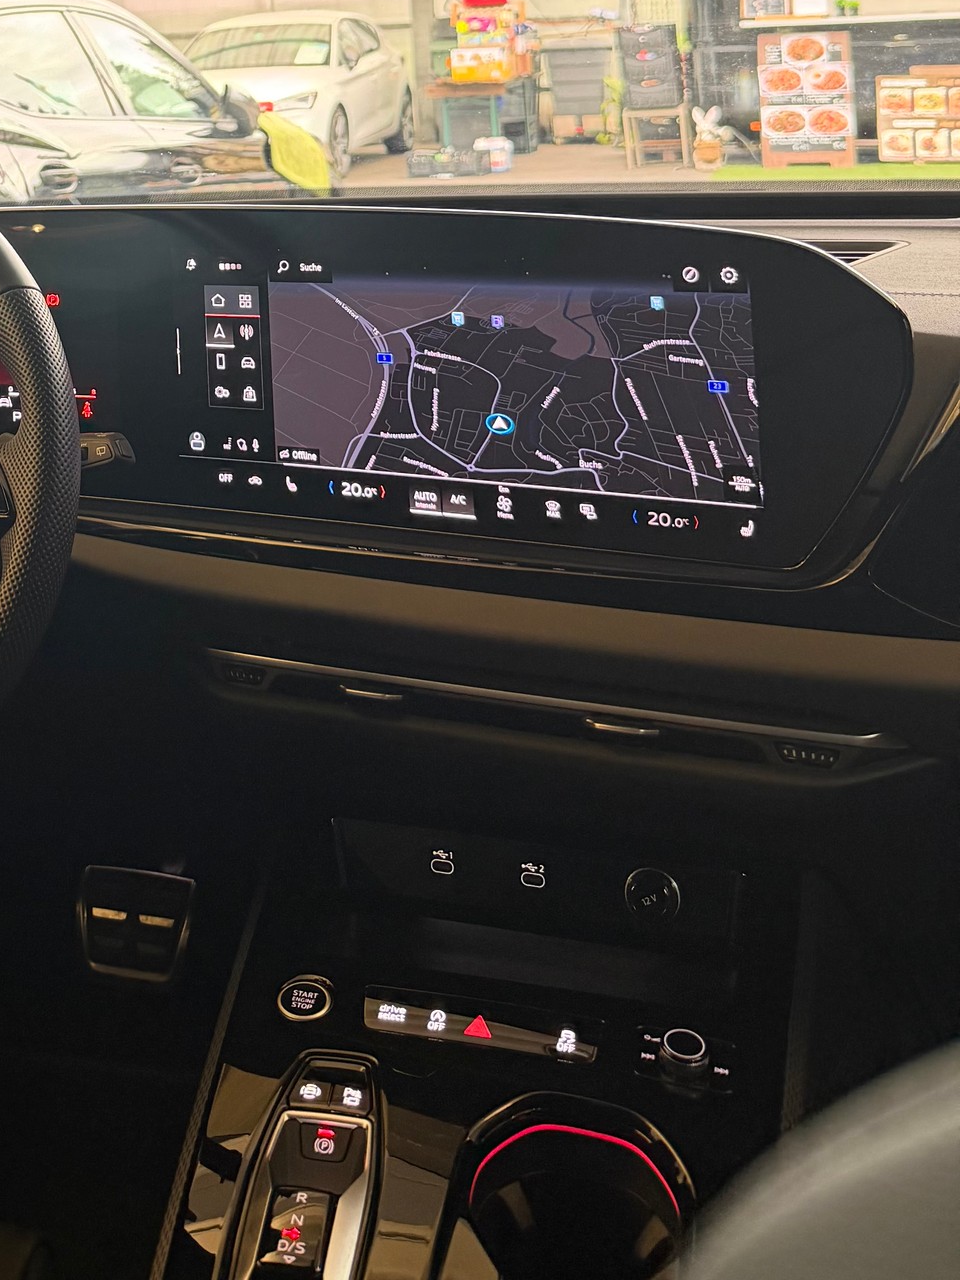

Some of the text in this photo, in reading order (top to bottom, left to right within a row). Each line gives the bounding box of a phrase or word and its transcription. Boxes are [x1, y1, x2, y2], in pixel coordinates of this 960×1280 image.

[299, 263, 322, 272] Suche
[424, 349, 461, 361] Fabrikstrasse
[668, 354, 703, 367] Gartenweg
[413, 362, 437, 375] Heuweg
[380, 431, 417, 439] Rohrerstrasse
[292, 451, 317, 462] Offline
[579, 460, 603, 470] Buchs
[219, 473, 233, 483] OFF
[732, 476, 752, 484] 150m
[498, 485, 510, 494] Eco
[414, 490, 437, 503] AUTO
[450, 493, 467, 506] A/C
[546, 510, 561, 519] MAX
[647, 511, 689, 528] 20.0°C
[539, 864, 545, 872] 2
[293, 989, 319, 999] START
[291, 1001, 313, 1010] STOP
[292, 996, 315, 1005] ENGINE
[379, 1004, 407, 1015] drive
[377, 1011, 406, 1022] select
[427, 1021, 446, 1031] OFF
[556, 1042, 576, 1053] OFF
[296, 1192, 308, 1203] R
[290, 1213, 304, 1226] N
[277, 1239, 306, 1254] D/S
